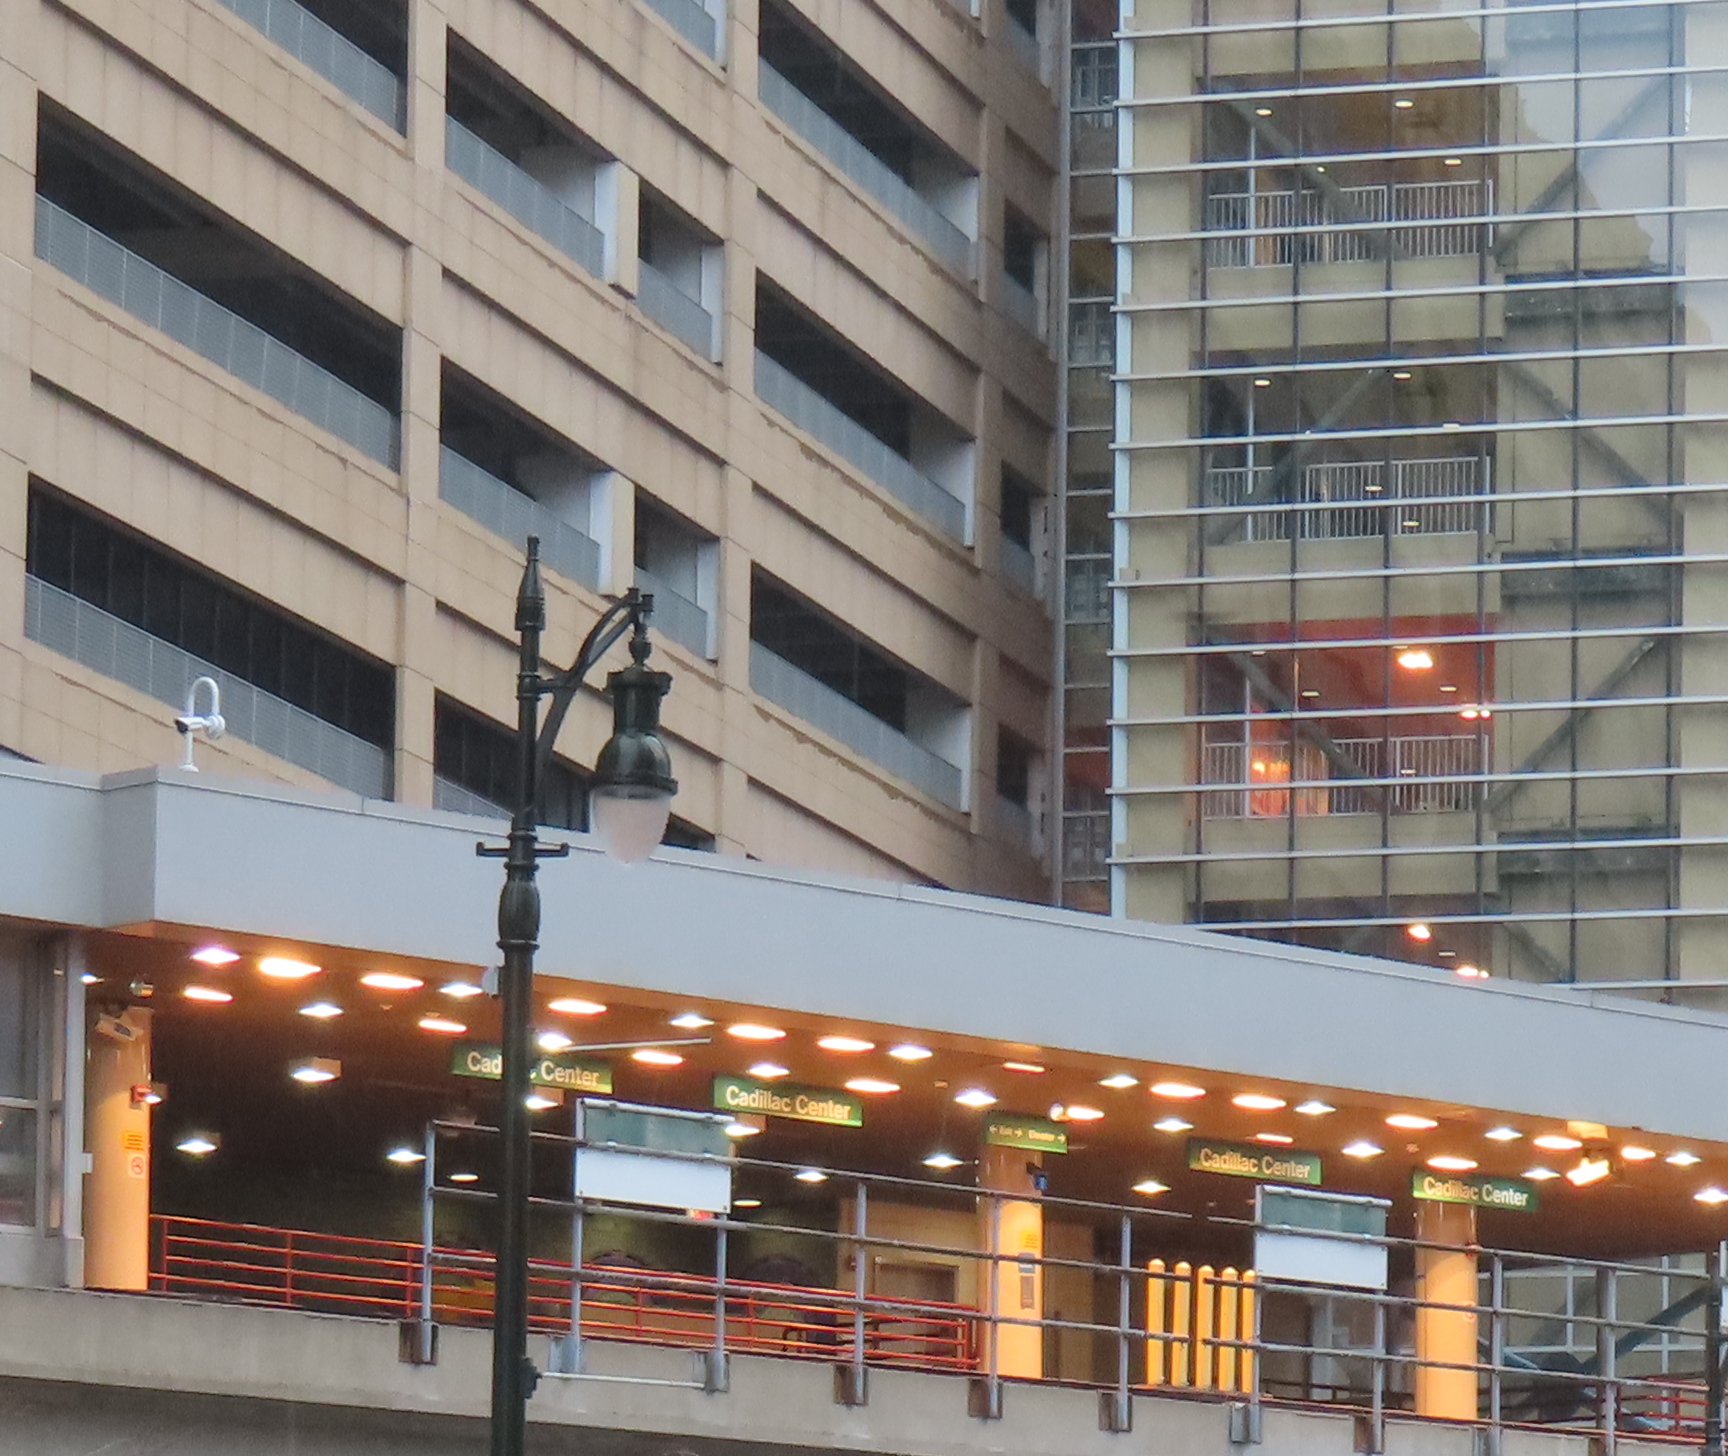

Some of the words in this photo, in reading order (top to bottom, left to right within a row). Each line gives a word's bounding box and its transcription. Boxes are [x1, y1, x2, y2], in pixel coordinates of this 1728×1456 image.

[540, 1060, 599, 1087] Center
[726, 1085, 791, 1112] Cadillac
[795, 1095, 851, 1120] Center
[1200, 1148, 1258, 1173] Cadillac
[1262, 1156, 1310, 1178] Center
[1423, 1176, 1478, 1200] Cadillac
[1482, 1184, 1529, 1206] Center
